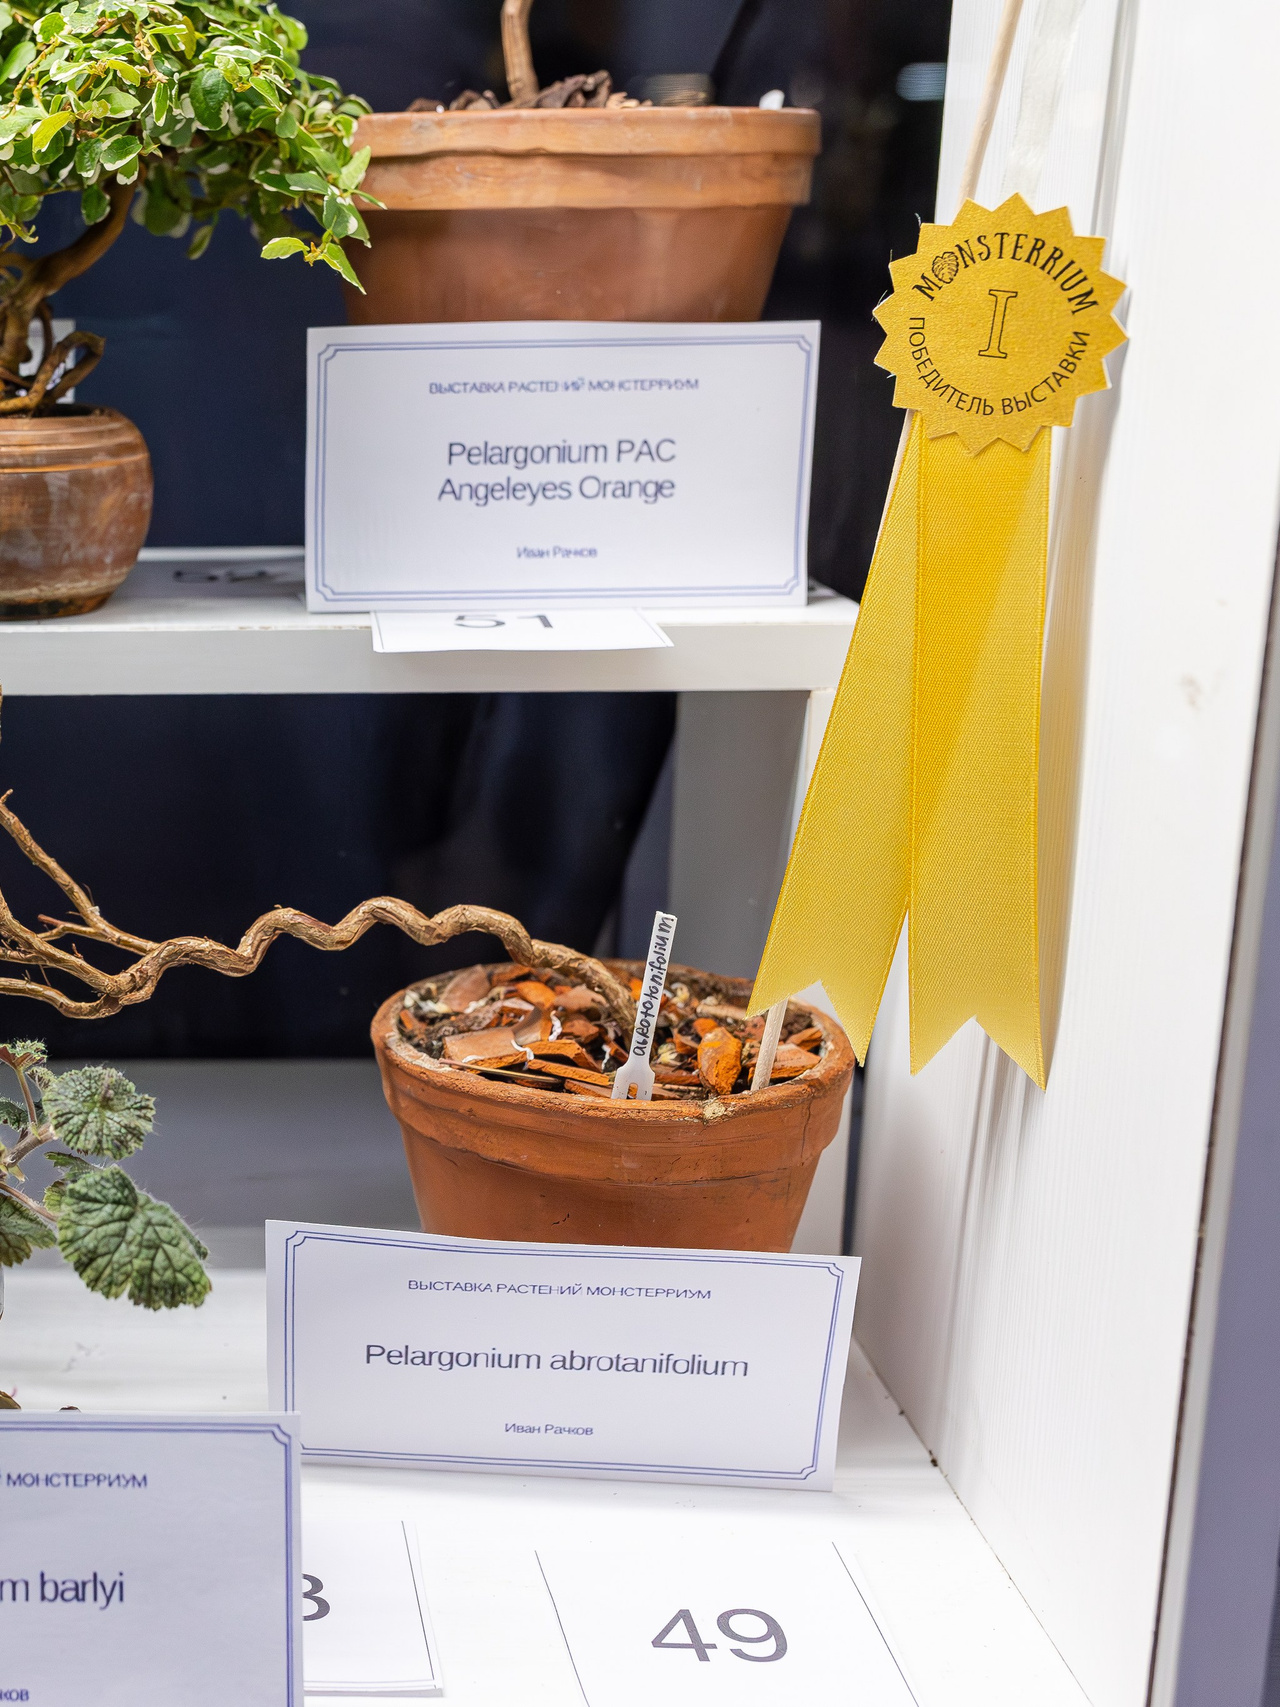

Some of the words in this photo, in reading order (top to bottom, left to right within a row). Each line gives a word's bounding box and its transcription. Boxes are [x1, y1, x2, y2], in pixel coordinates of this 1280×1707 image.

[977, 288, 1018, 360] I
[908, 317, 995, 416] ПОБЕДИТЕЛЬ
[1001, 330, 1091, 415] ВЫСТАВКИ
[448, 440, 608, 470] Pelargonium
[616, 438, 677, 463] PAC
[438, 476, 572, 507] Angeleyes
[579, 475, 676, 505] Orange
[408, 1280, 494, 1293] ВЫСТАВКА
[496, 1283, 583, 1296] РАСТЕНИЙ
[586, 1286, 712, 1299] МОНСТЕРРИУМ
[365, 1344, 541, 1371] Pelargonium
[550, 1350, 749, 1377] abrotanifolium
[505, 1423, 541, 1435] Иван
[544, 1424, 594, 1436] Рачков
[6, 1472, 148, 1489] МОНСТЕРРИУМ
[39, 1571, 124, 1611] barlyi
[651, 1608, 789, 1663] 49
